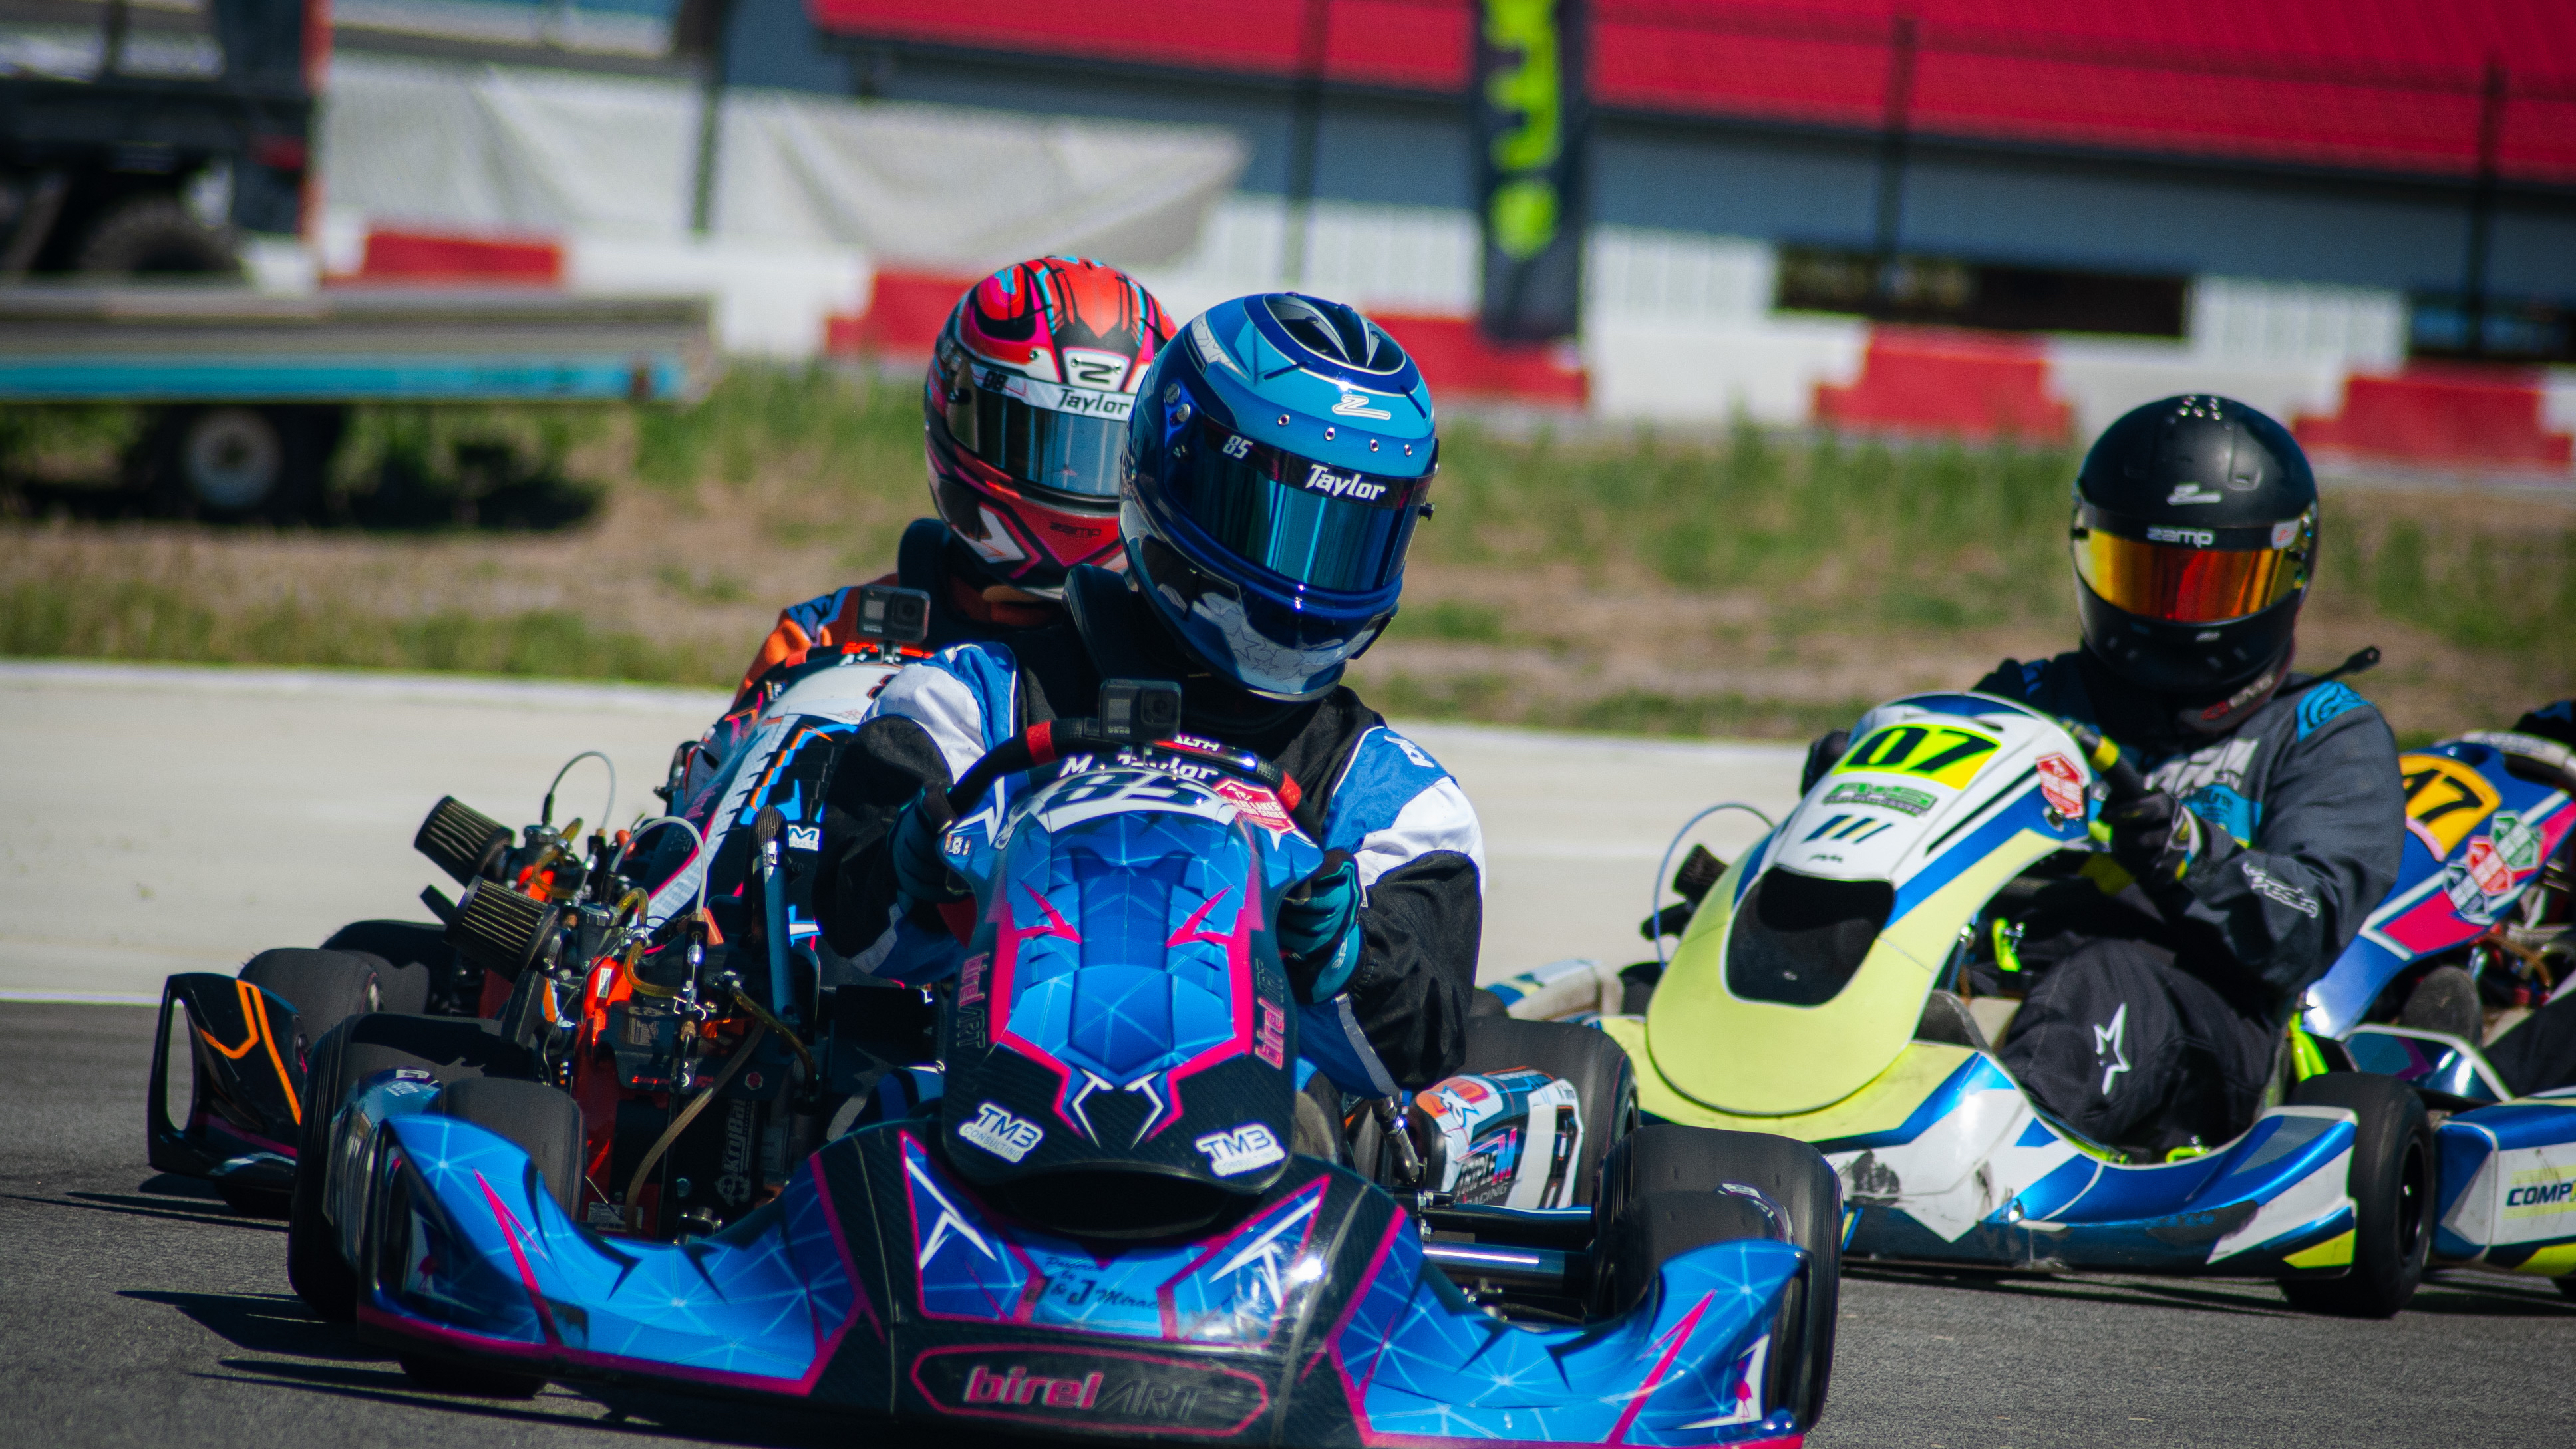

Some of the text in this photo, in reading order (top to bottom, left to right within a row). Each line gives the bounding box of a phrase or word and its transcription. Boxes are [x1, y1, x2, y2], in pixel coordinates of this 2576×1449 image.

[1058, 388, 1131, 415] Taylor
[1223, 434, 1253, 459] 85
[1305, 464, 1386, 500] Taylor
[2146, 525, 2215, 548] zamp
[1845, 726, 1999, 774] 07
[1117, 754, 1219, 780] Tlor
[964, 1126, 1023, 1159] CONSULTING
[978, 1106, 1039, 1149] TM3
[1202, 1130, 1271, 1160] TM3
